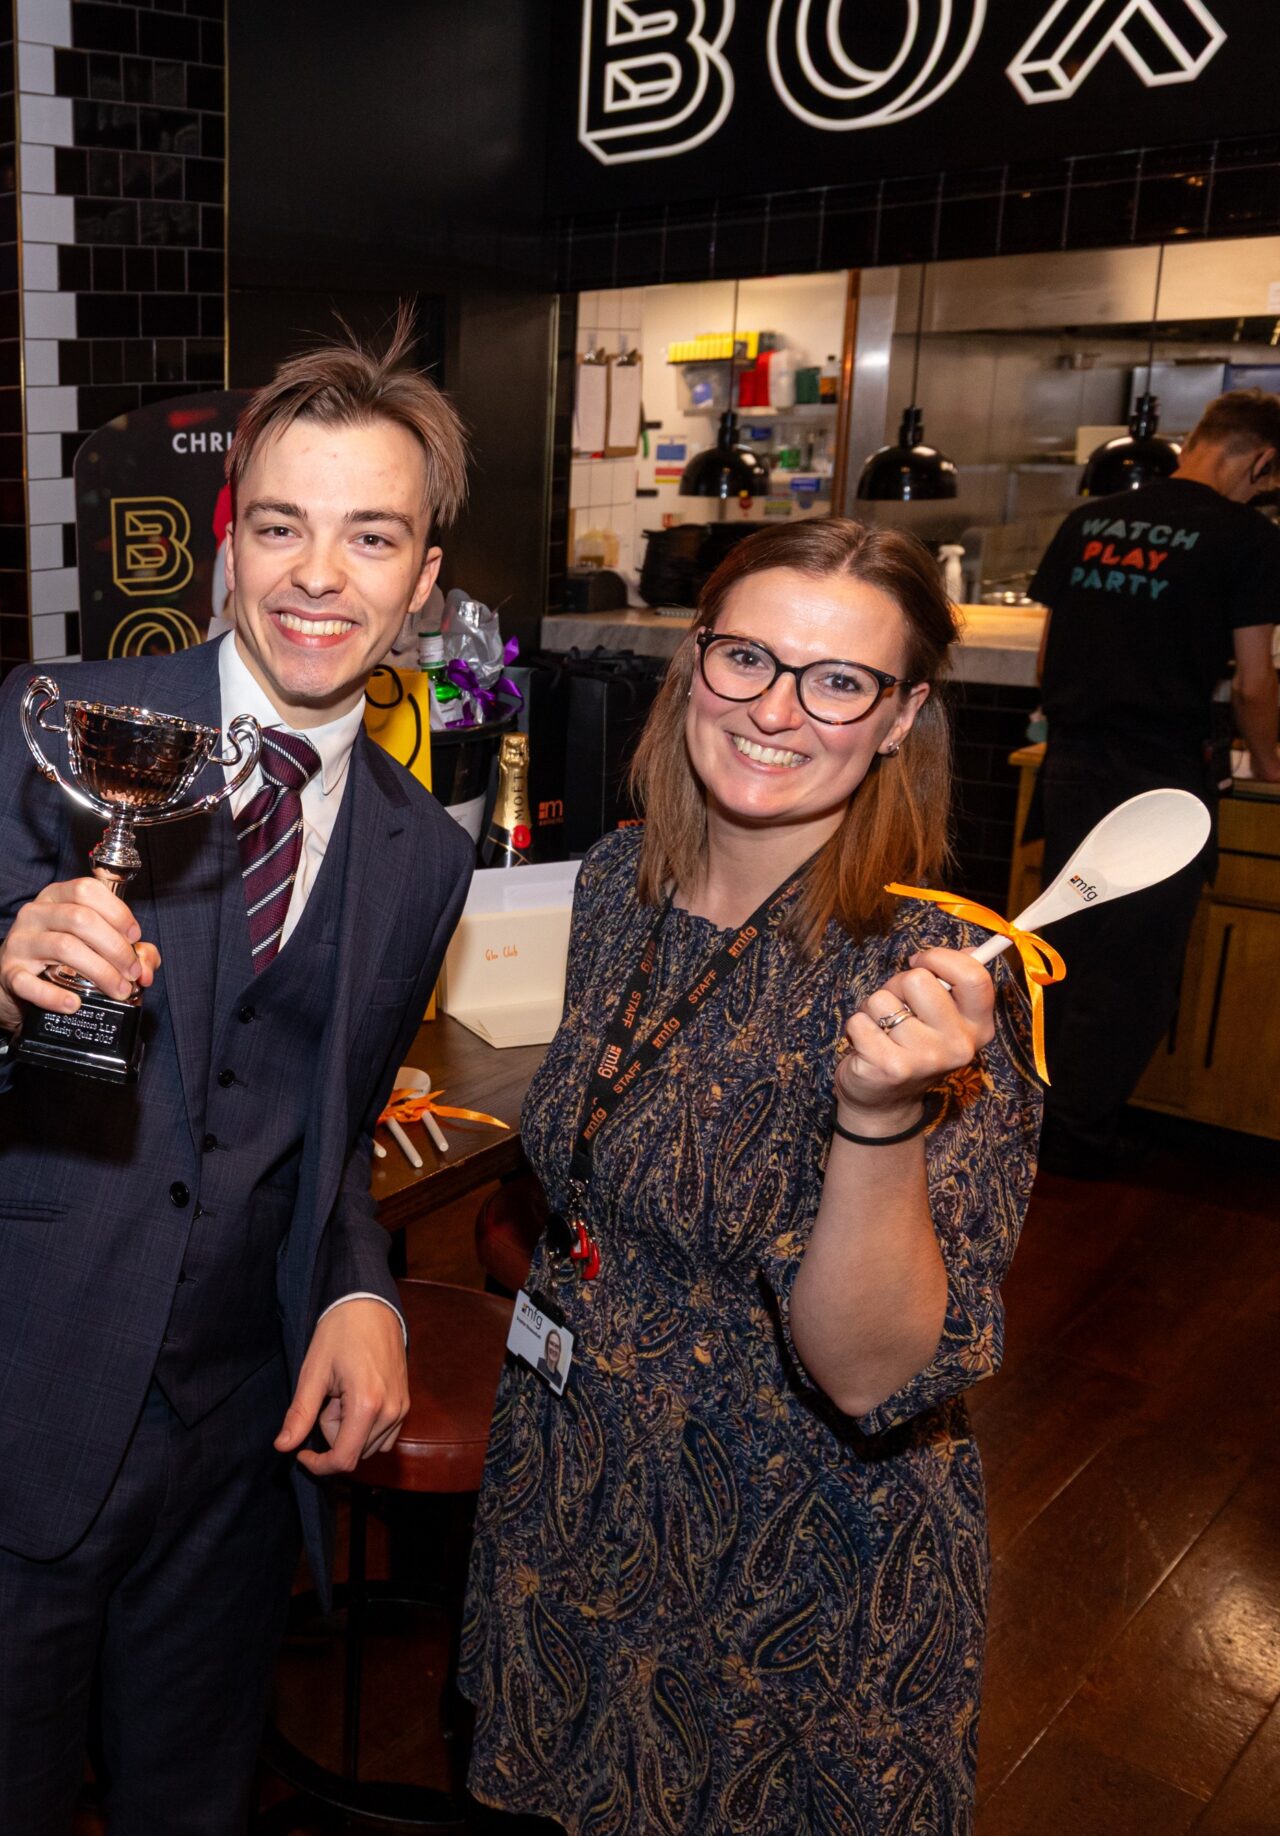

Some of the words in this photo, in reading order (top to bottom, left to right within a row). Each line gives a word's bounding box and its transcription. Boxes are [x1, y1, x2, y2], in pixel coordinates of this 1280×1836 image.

[1082, 518, 1200, 550] WATCH
[1083, 540, 1168, 572] PLAY
[1071, 566, 1168, 600] PARTY
[1073, 876, 1099, 902] mfg
[62, 1015, 98, 1031] Solicitors
[99, 1022, 117, 1034] LLP
[613, 1060, 642, 1094] STAFF
[653, 1016, 680, 1047] mfg
[688, 970, 718, 1004] STAFF
[730, 925, 758, 956] mfg
[621, 991, 642, 1029] STAFF
[44, 1022, 72, 1037] Charity
[74, 1028, 93, 1040] Quiz
[597, 1046, 621, 1079] mfg
[526, 1305, 544, 1331] mfg
